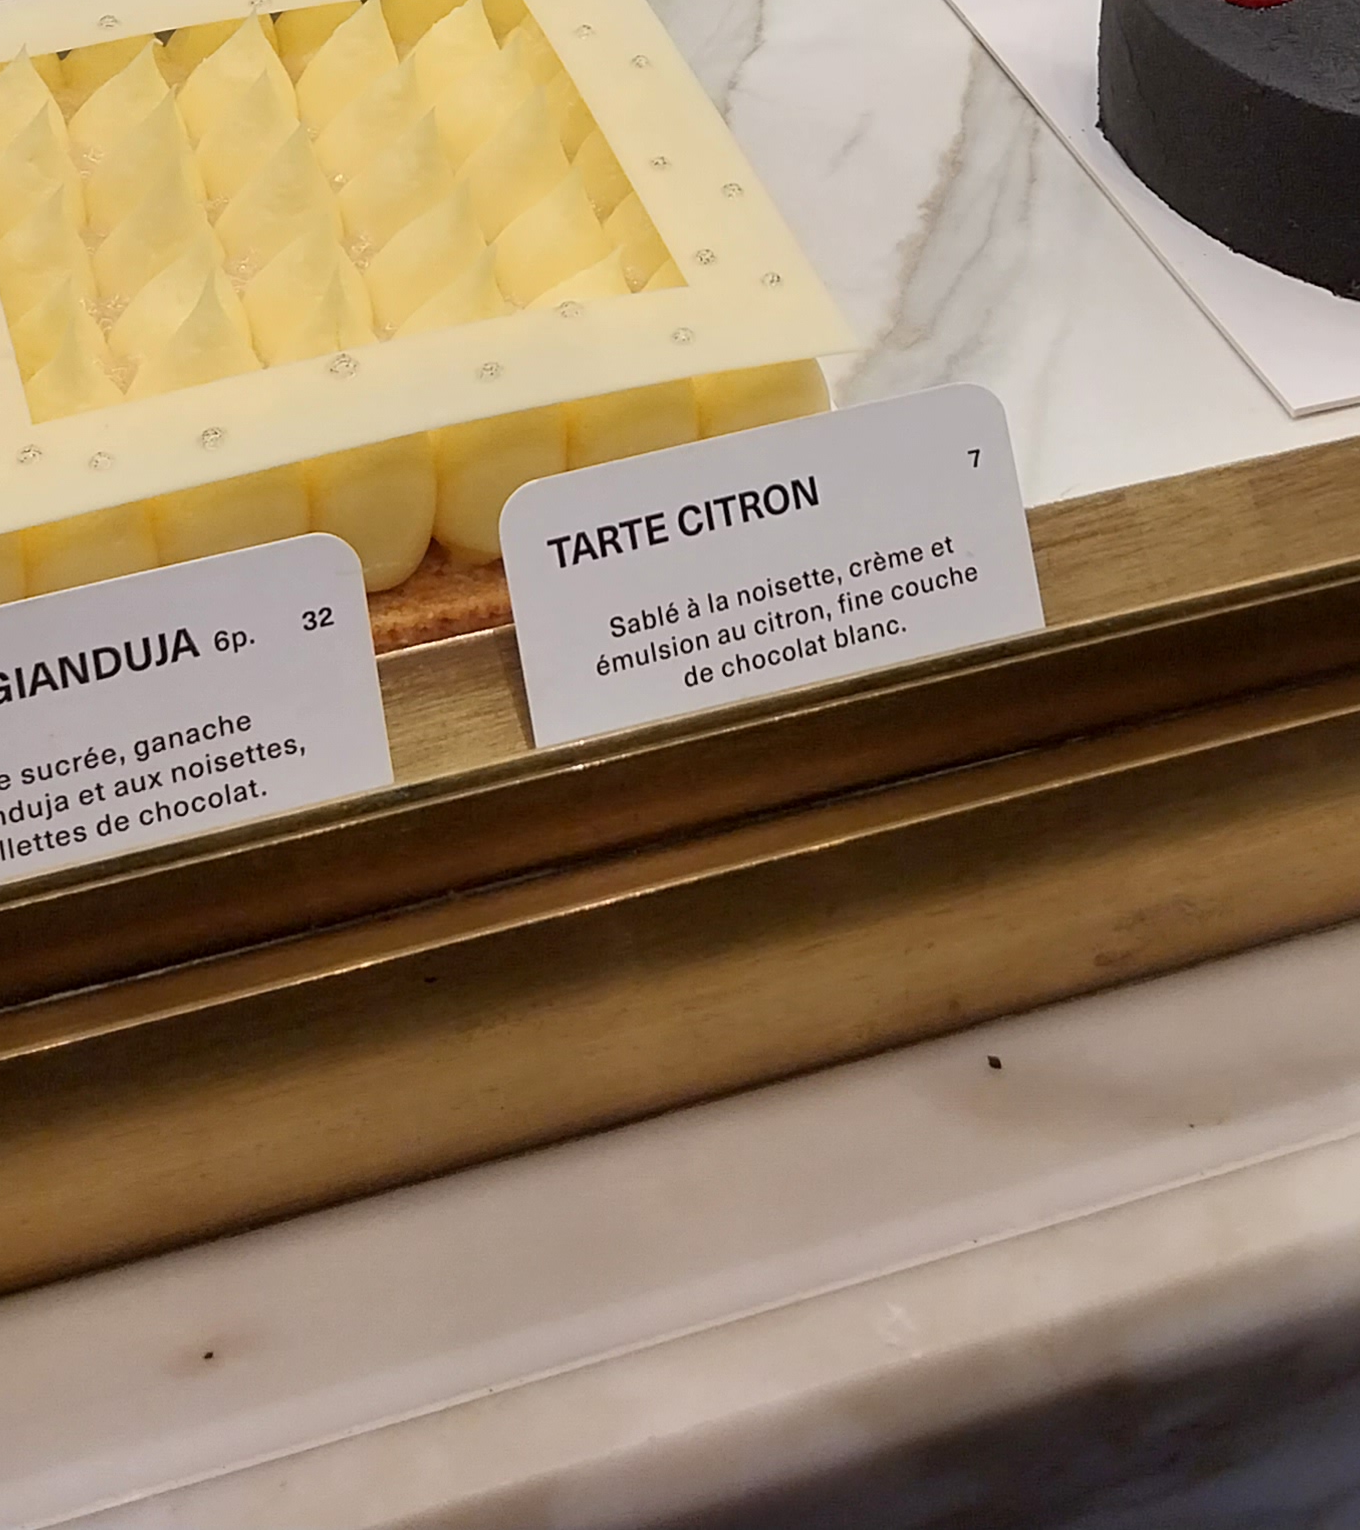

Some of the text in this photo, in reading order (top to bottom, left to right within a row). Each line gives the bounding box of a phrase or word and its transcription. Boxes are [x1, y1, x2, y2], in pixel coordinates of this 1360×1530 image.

[547, 449, 982, 569] TARTE CITRON 7
[596, 563, 979, 676] émulsion au citron, fine couche
[610, 535, 954, 638] Sablé à la noisette, crème et
[213, 629, 256, 653] 6p.
[302, 606, 335, 631] 32
[684, 617, 907, 687] de chocolat blanc.
[21, 745, 125, 785] sucrée,
[134, 713, 252, 762] ganache
[79, 782, 106, 806] et
[114, 769, 163, 797] aux
[171, 734, 306, 785] noisettes,
[96, 809, 130, 836] de
[139, 781, 268, 826] chocolat.
